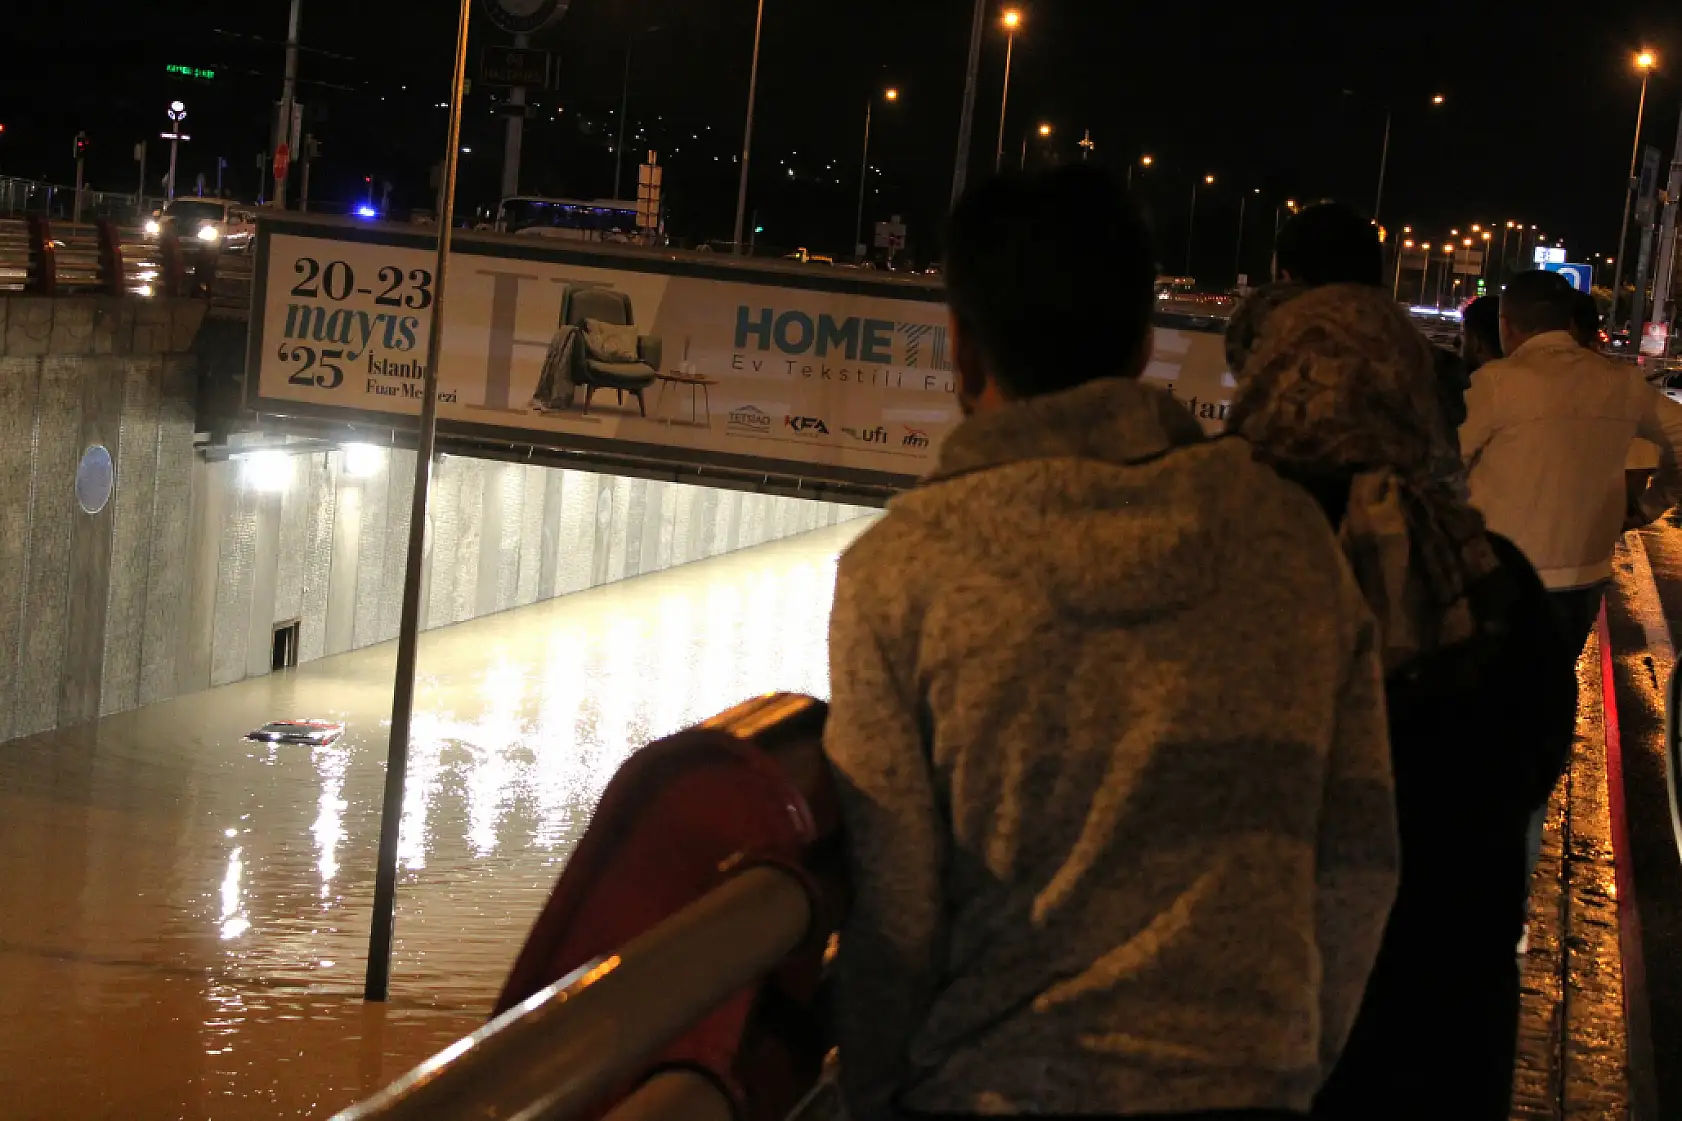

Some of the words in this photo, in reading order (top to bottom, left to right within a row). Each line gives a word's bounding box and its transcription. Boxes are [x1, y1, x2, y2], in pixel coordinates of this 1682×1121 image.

[290, 257, 432, 310] 20-23
[283, 303, 419, 361] mayıs
[366, 378, 400, 397] Fuar
[732, 354, 764, 372] Ev
[785, 360, 902, 388] Tekstili
[924, 374, 956, 394] Fu
[784, 414, 829, 434] KFA
